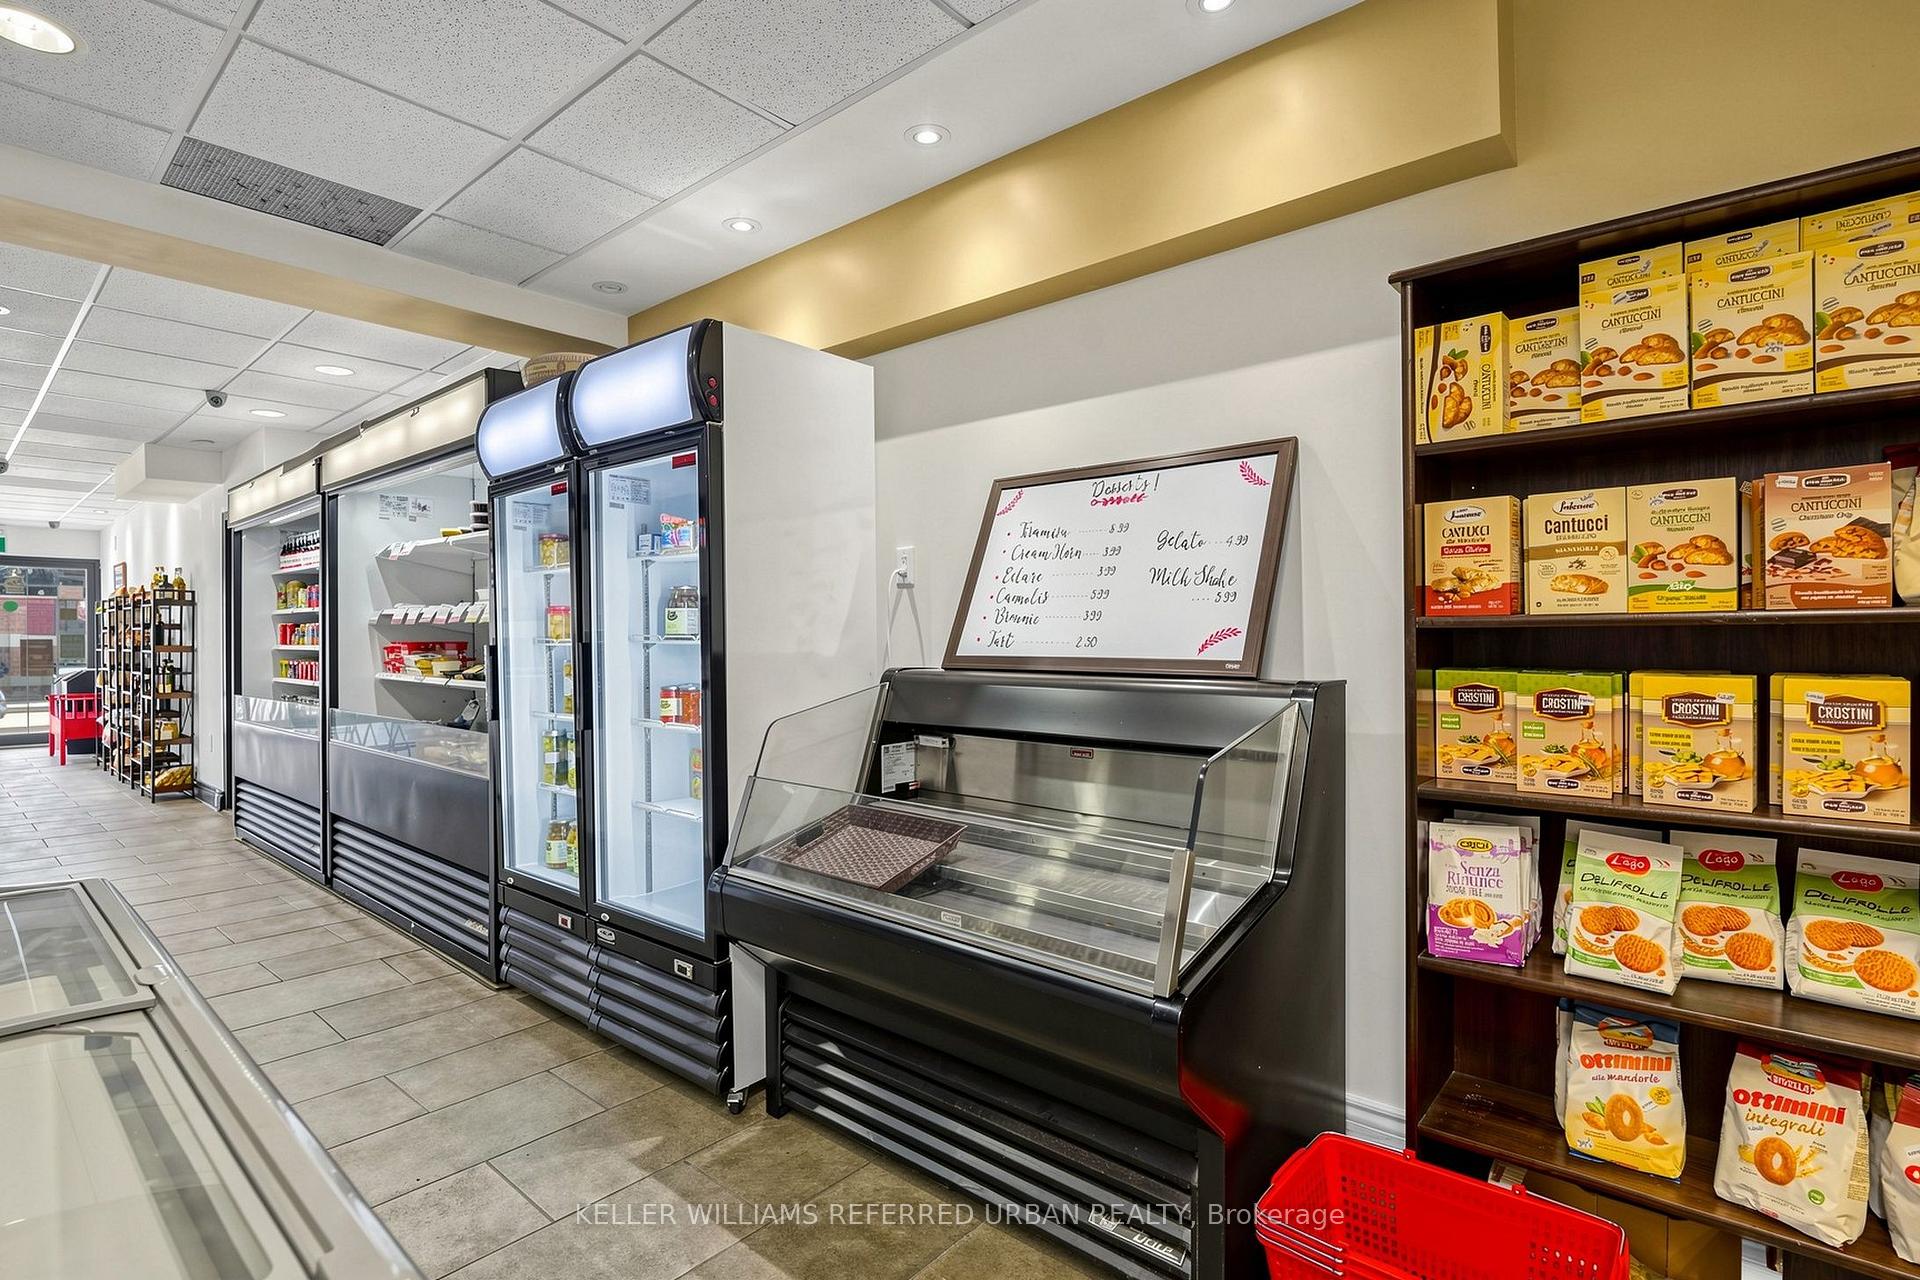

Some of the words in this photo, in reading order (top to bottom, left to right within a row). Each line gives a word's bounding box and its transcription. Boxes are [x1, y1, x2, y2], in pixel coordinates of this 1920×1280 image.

[1716, 288, 1785, 309] CANTUCCINI
[1601, 307, 1662, 329] CANTUCCINI
[1791, 497, 1862, 513] CANTUCCINI
[1544, 514, 1609, 535] Cantucci
[1650, 512, 1711, 526] CANTUCCINI
[1157, 529, 1206, 550] Gelato
[1441, 525, 1490, 539] CANTUCCI
[1149, 567, 1192, 587] Milk
[1193, 564, 1237, 588] Shake
[1457, 692, 1495, 705] CROSTINI
[1671, 702, 1720, 717] CROSTINI
[1817, 706, 1874, 721] CROSTINI
[1460, 861, 1501, 877] Senza
[1580, 872, 1669, 900] DELIFROLLE
[1681, 873, 1774, 892] DELIFROLLE
[1803, 888, 1912, 915] DELIFROLLE
[1744, 1108, 1826, 1137] integrali
